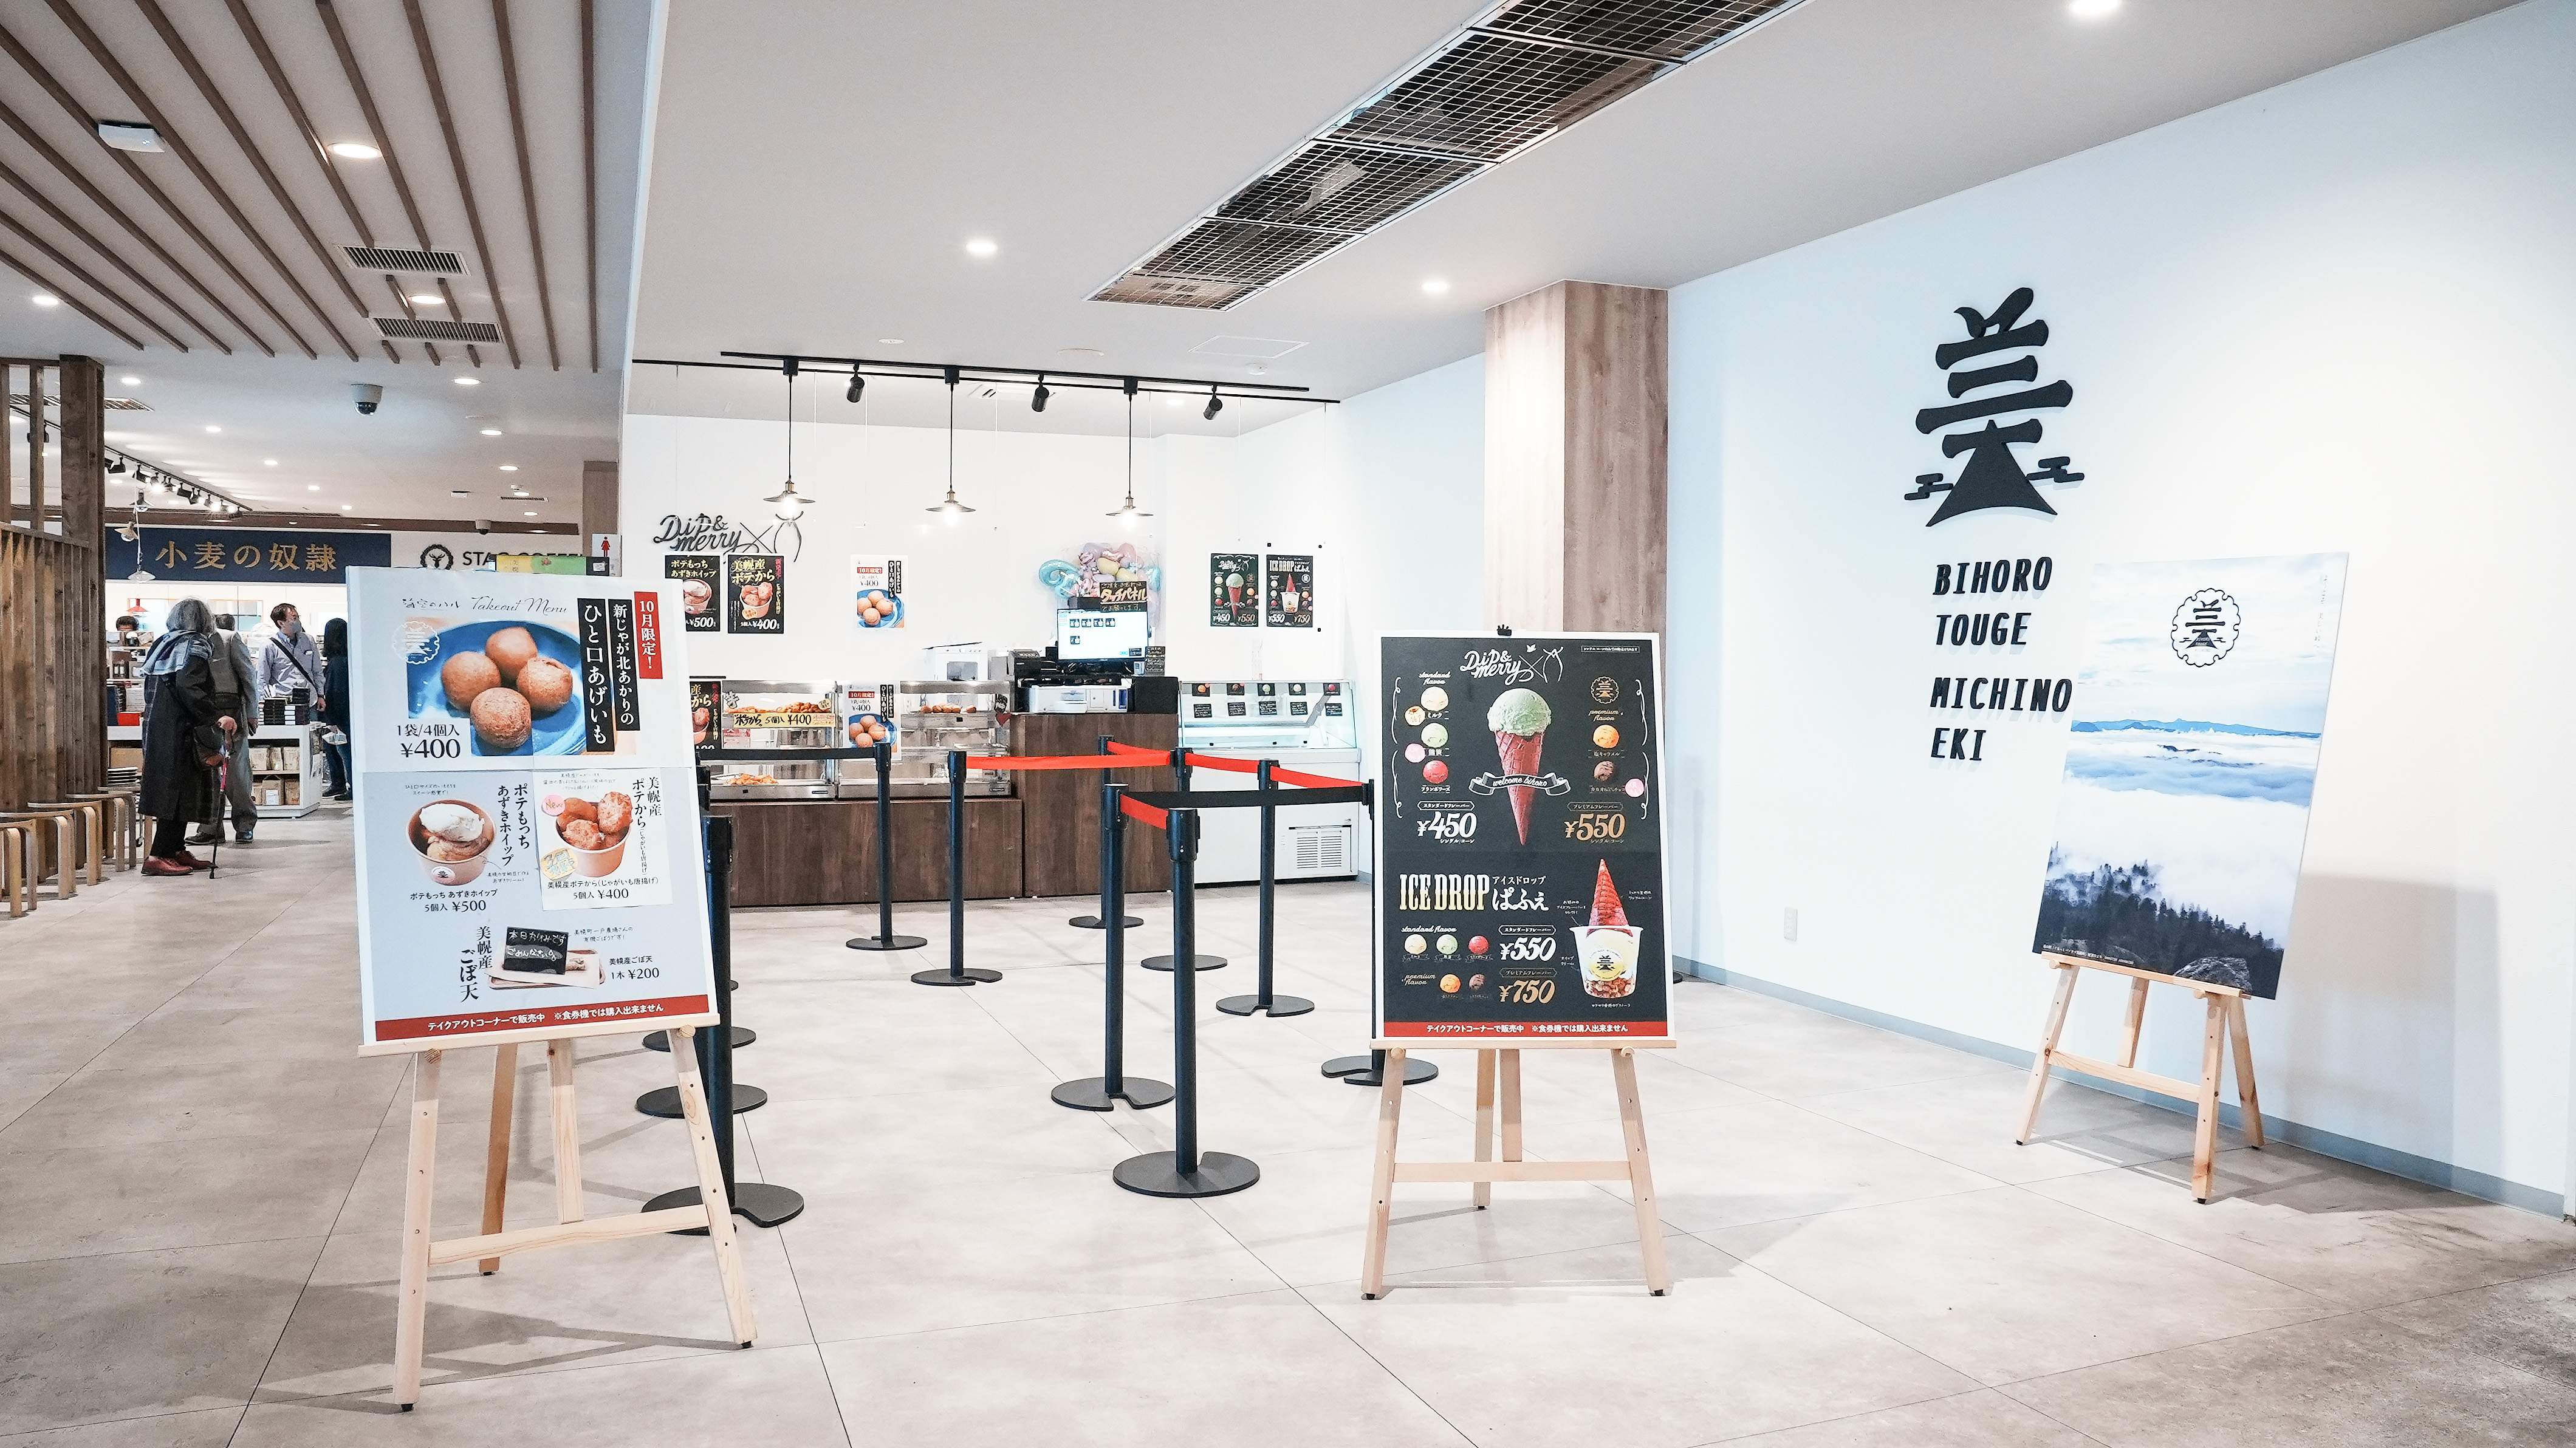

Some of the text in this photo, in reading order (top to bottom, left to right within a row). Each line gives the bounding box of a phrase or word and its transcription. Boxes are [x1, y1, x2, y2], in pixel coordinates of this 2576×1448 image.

[155, 540, 337, 572] 小麦の奴隷
[462, 552, 509, 565] STA
[671, 559, 708, 569] ポテもっち
[731, 569, 775, 584] ポテから
[1933, 556, 2052, 595] BIHORO
[471, 596, 521, 612] Takeout
[521, 597, 567, 616] Menu
[639, 600, 656, 669] 10月限定!
[752, 618, 777, 630] ¥400
[1936, 612, 2032, 646] TOUGE
[584, 605, 608, 744] ひと口あげいも
[612, 604, 634, 725] 新じゃが北あかりの
[1930, 677, 2072, 712] MICHINO
[788, 714, 811, 726] ¥400
[400, 739, 461, 759] ¥400
[1931, 728, 1987, 761] EKI
[1492, 776, 1523, 787] welcome
[647, 777, 662, 817] 美幌産
[498, 785, 514, 866] あずきホイップ
[514, 783, 530, 849] ポテもっち
[1416, 811, 1626, 841] ¥450 ¥550
[1399, 873, 1490, 910] ICE DROP
[1492, 875, 1547, 885] アイスドロップ
[410, 889, 498, 901] ポテもっち あずきホイップ
[425, 900, 486, 912] 5個入 ¥500
[598, 888, 629, 900] ¥400
[1433, 925, 1457, 934] flavor
[476, 926, 493, 970] 美幌産
[1499, 937, 1557, 961] ¥550
[460, 949, 479, 1003] ごぼ天
[628, 967, 659, 980] ¥200
[1498, 979, 1556, 1004] ¥750
[428, 1013, 545, 1031] テイクアウトコーナーで販売中
[1426, 1025, 1524, 1034] テイクアウトコーナーで販売中
